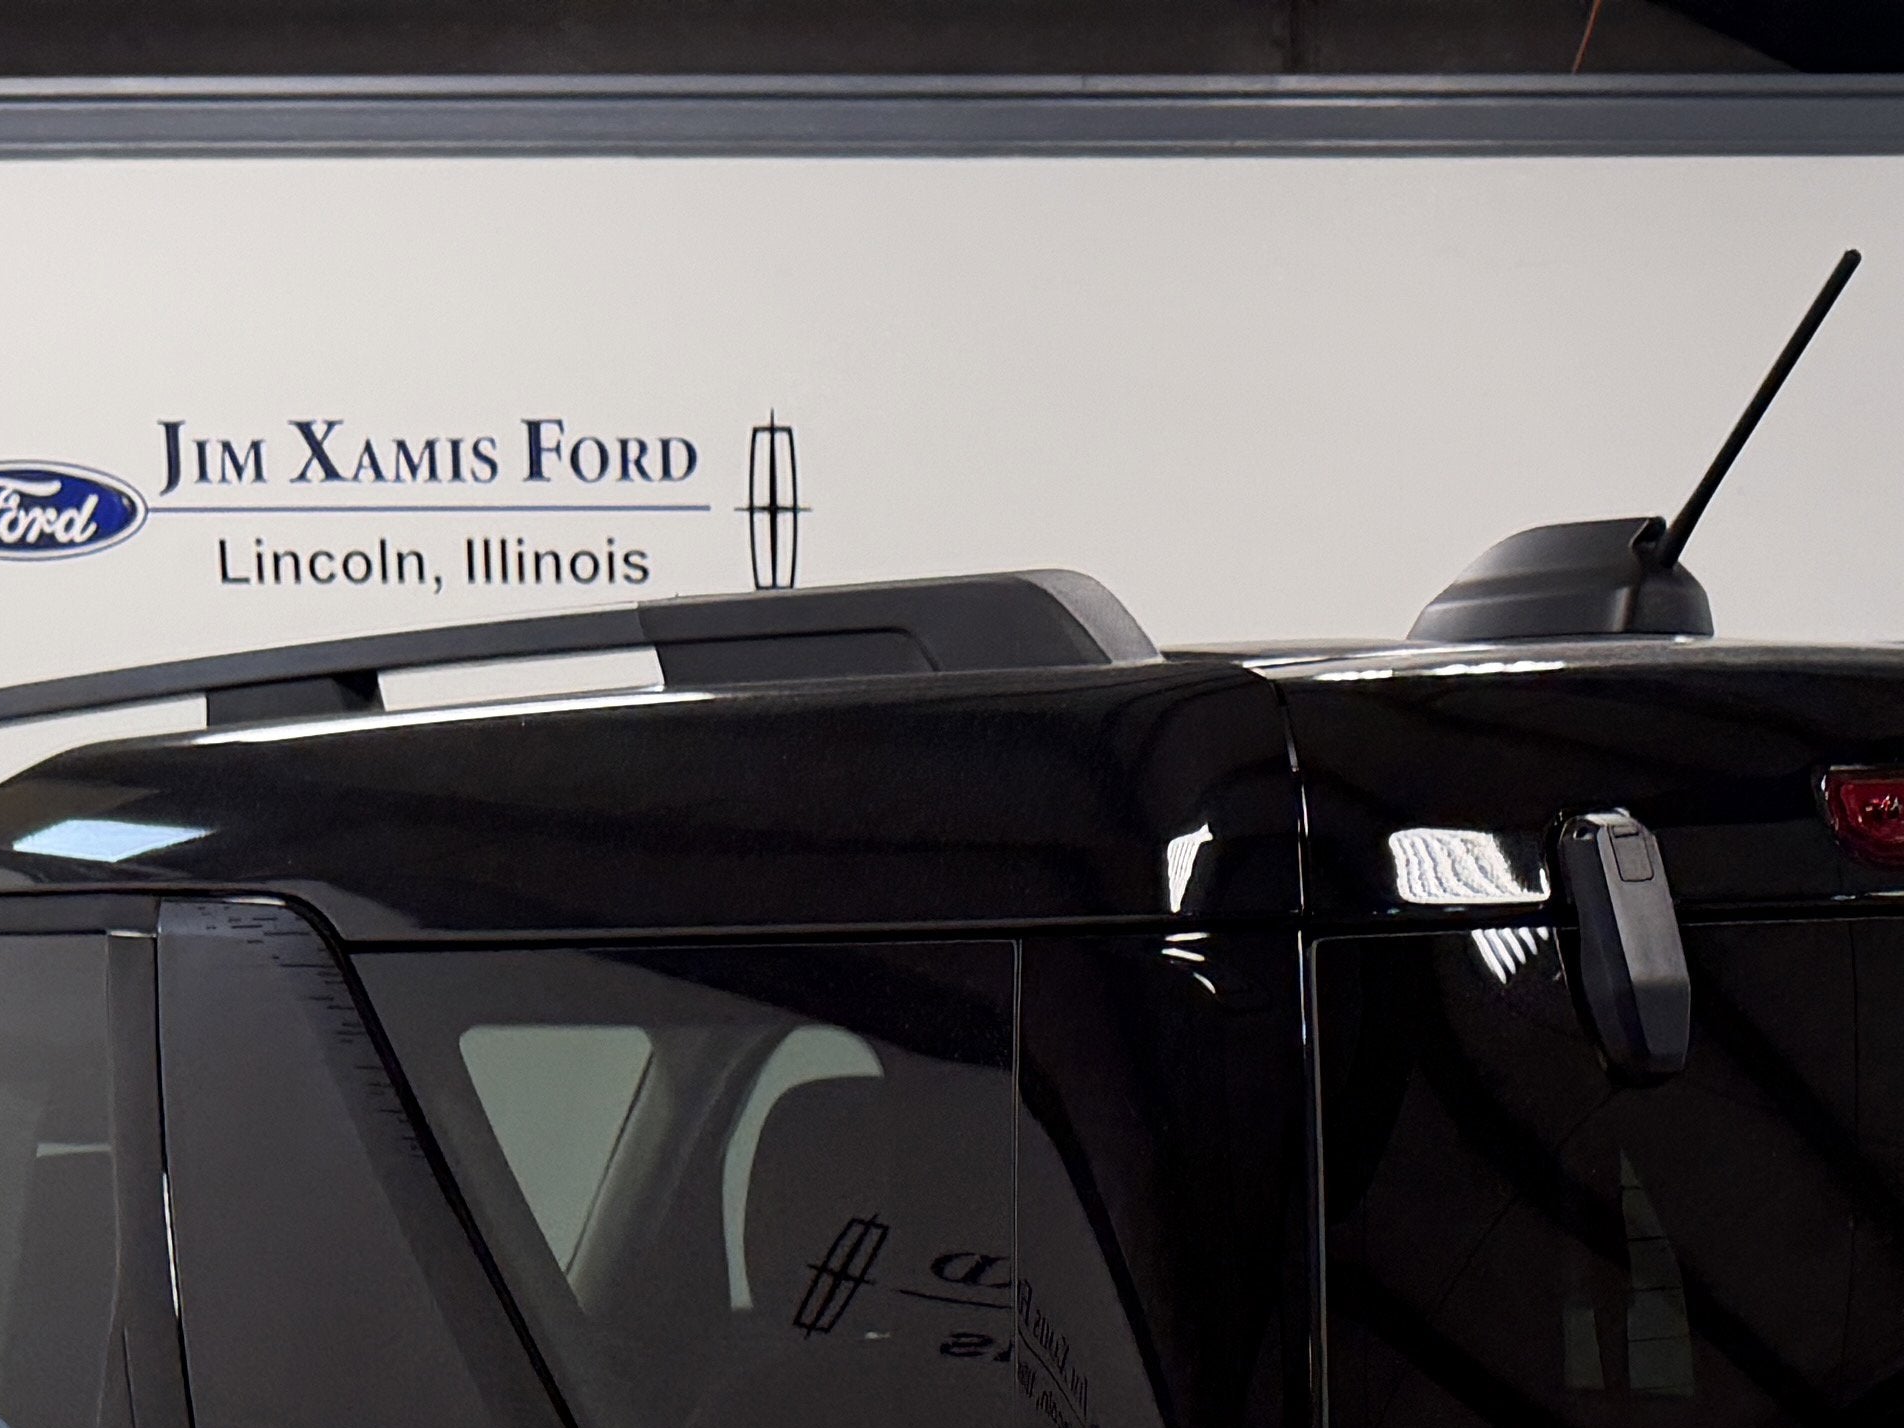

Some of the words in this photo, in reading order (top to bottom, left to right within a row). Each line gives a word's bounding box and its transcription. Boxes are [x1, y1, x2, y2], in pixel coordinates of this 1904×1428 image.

[156, 419, 265, 497] JIM
[288, 419, 499, 484] XAMIS
[521, 418, 698, 484] FORD
[220, 538, 443, 592] Lincoln,
[466, 536, 649, 585] Illinois
